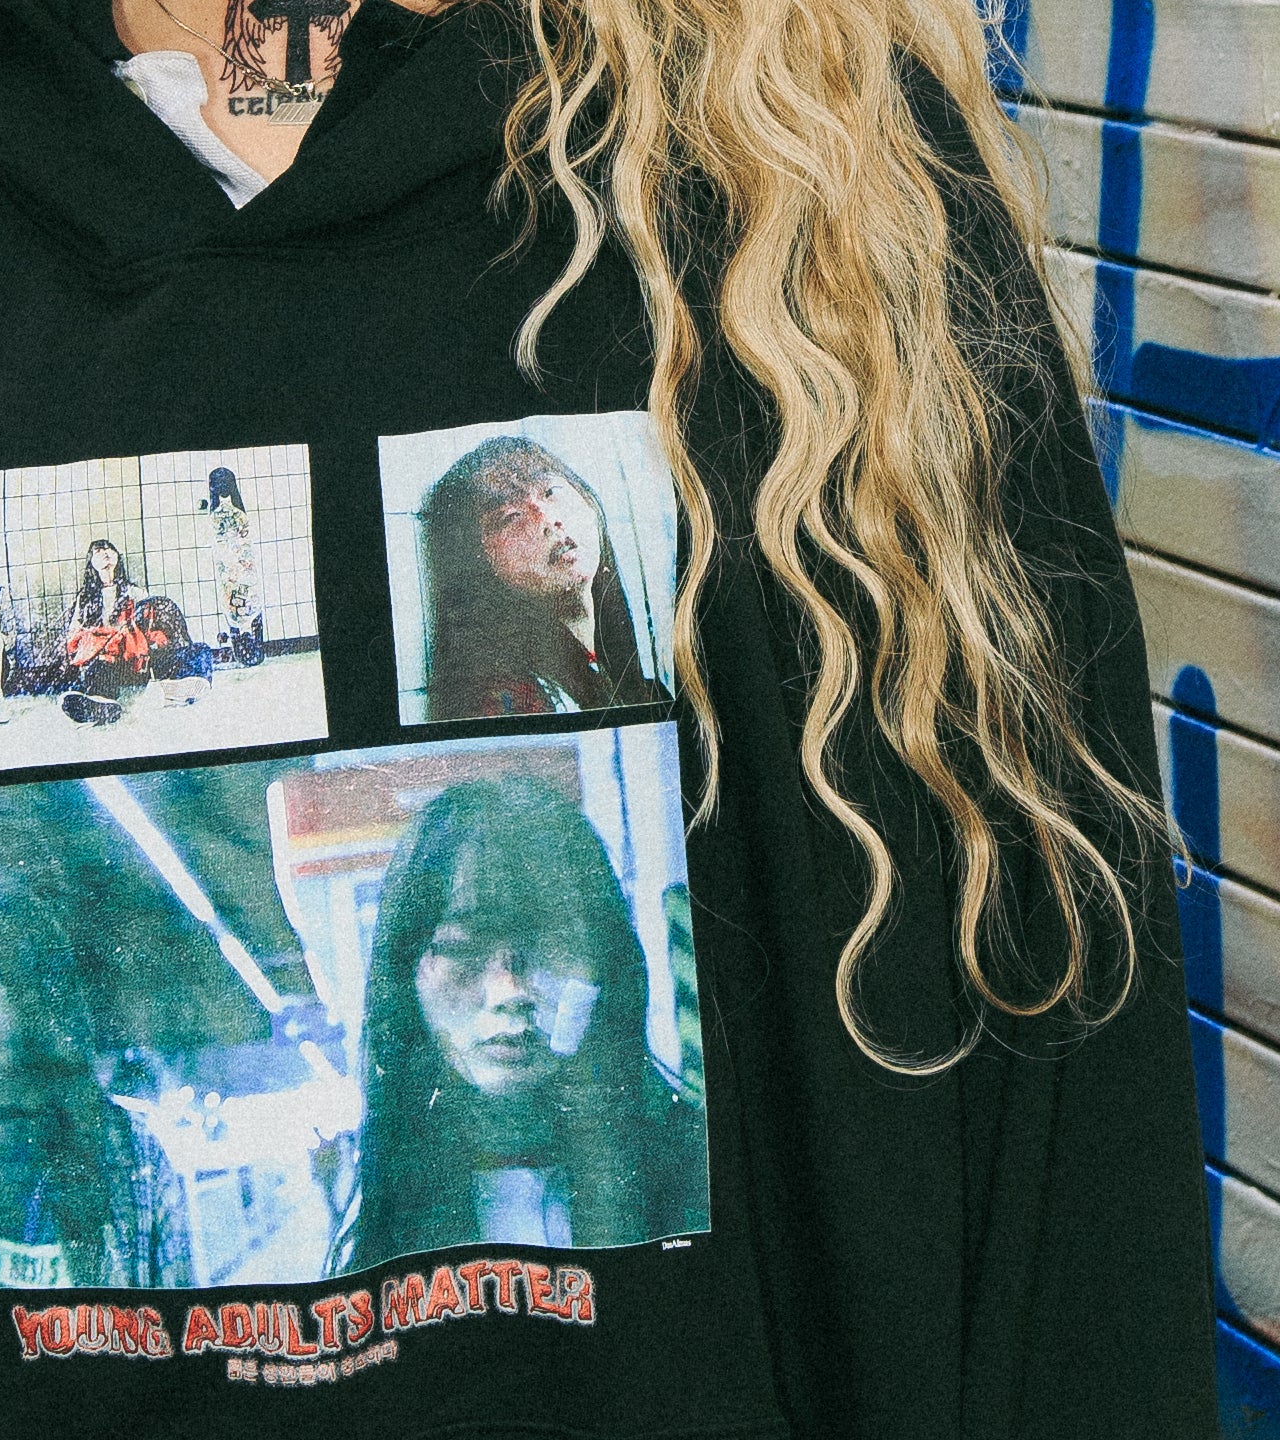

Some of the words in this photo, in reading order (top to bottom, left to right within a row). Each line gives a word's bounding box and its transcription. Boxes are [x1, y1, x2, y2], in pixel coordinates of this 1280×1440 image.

[11, 1302, 175, 1360] YOUNG
[183, 1287, 376, 1360] ADULTS
[381, 1259, 598, 1331] MATTER
